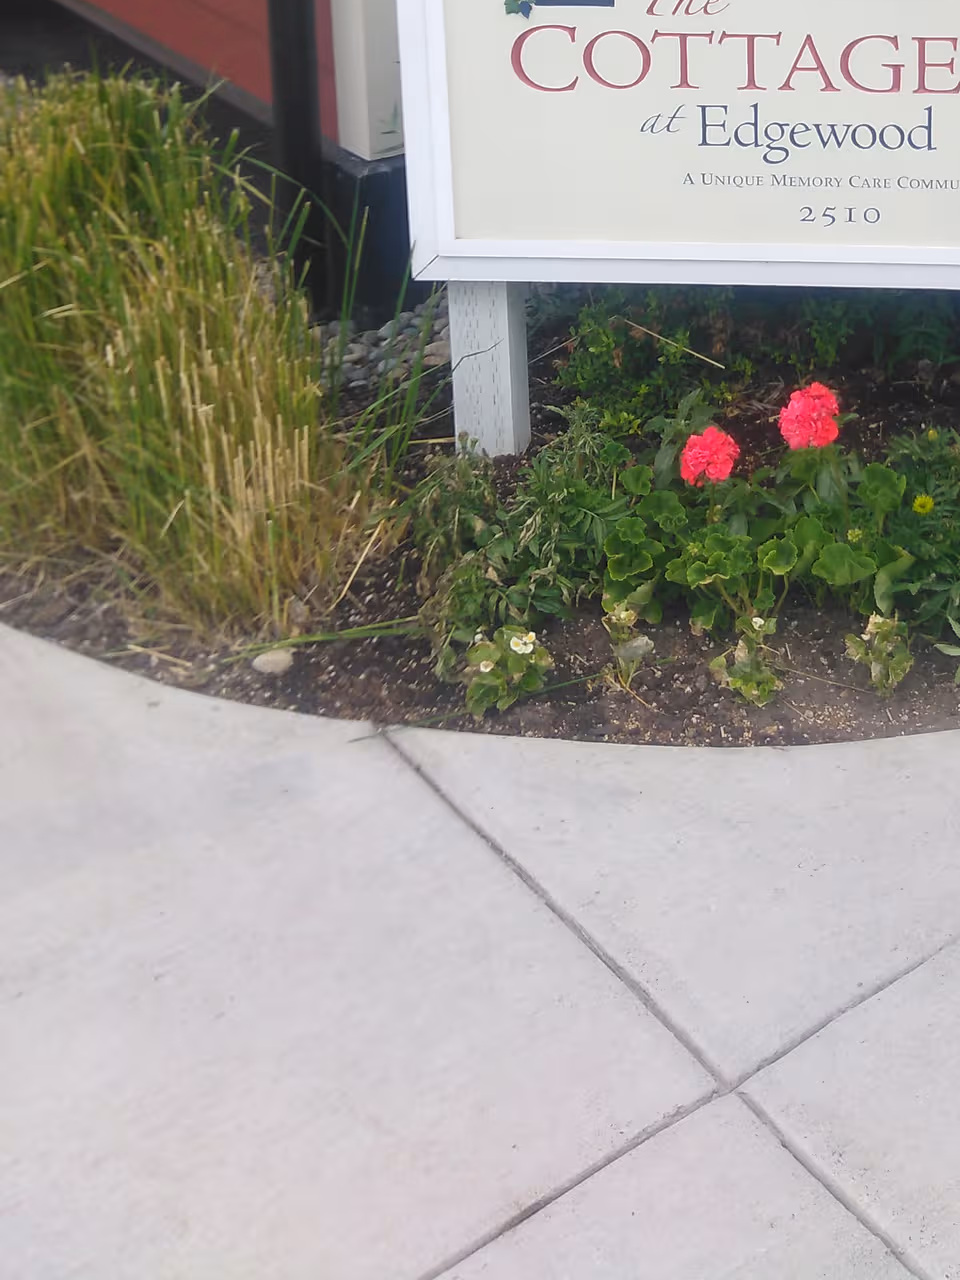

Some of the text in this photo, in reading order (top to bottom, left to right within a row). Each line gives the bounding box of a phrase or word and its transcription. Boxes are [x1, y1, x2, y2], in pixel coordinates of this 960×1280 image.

[640, 103, 937, 164] at Edgewood
[682, 172, 695, 186] A
[799, 205, 882, 226] 2510
